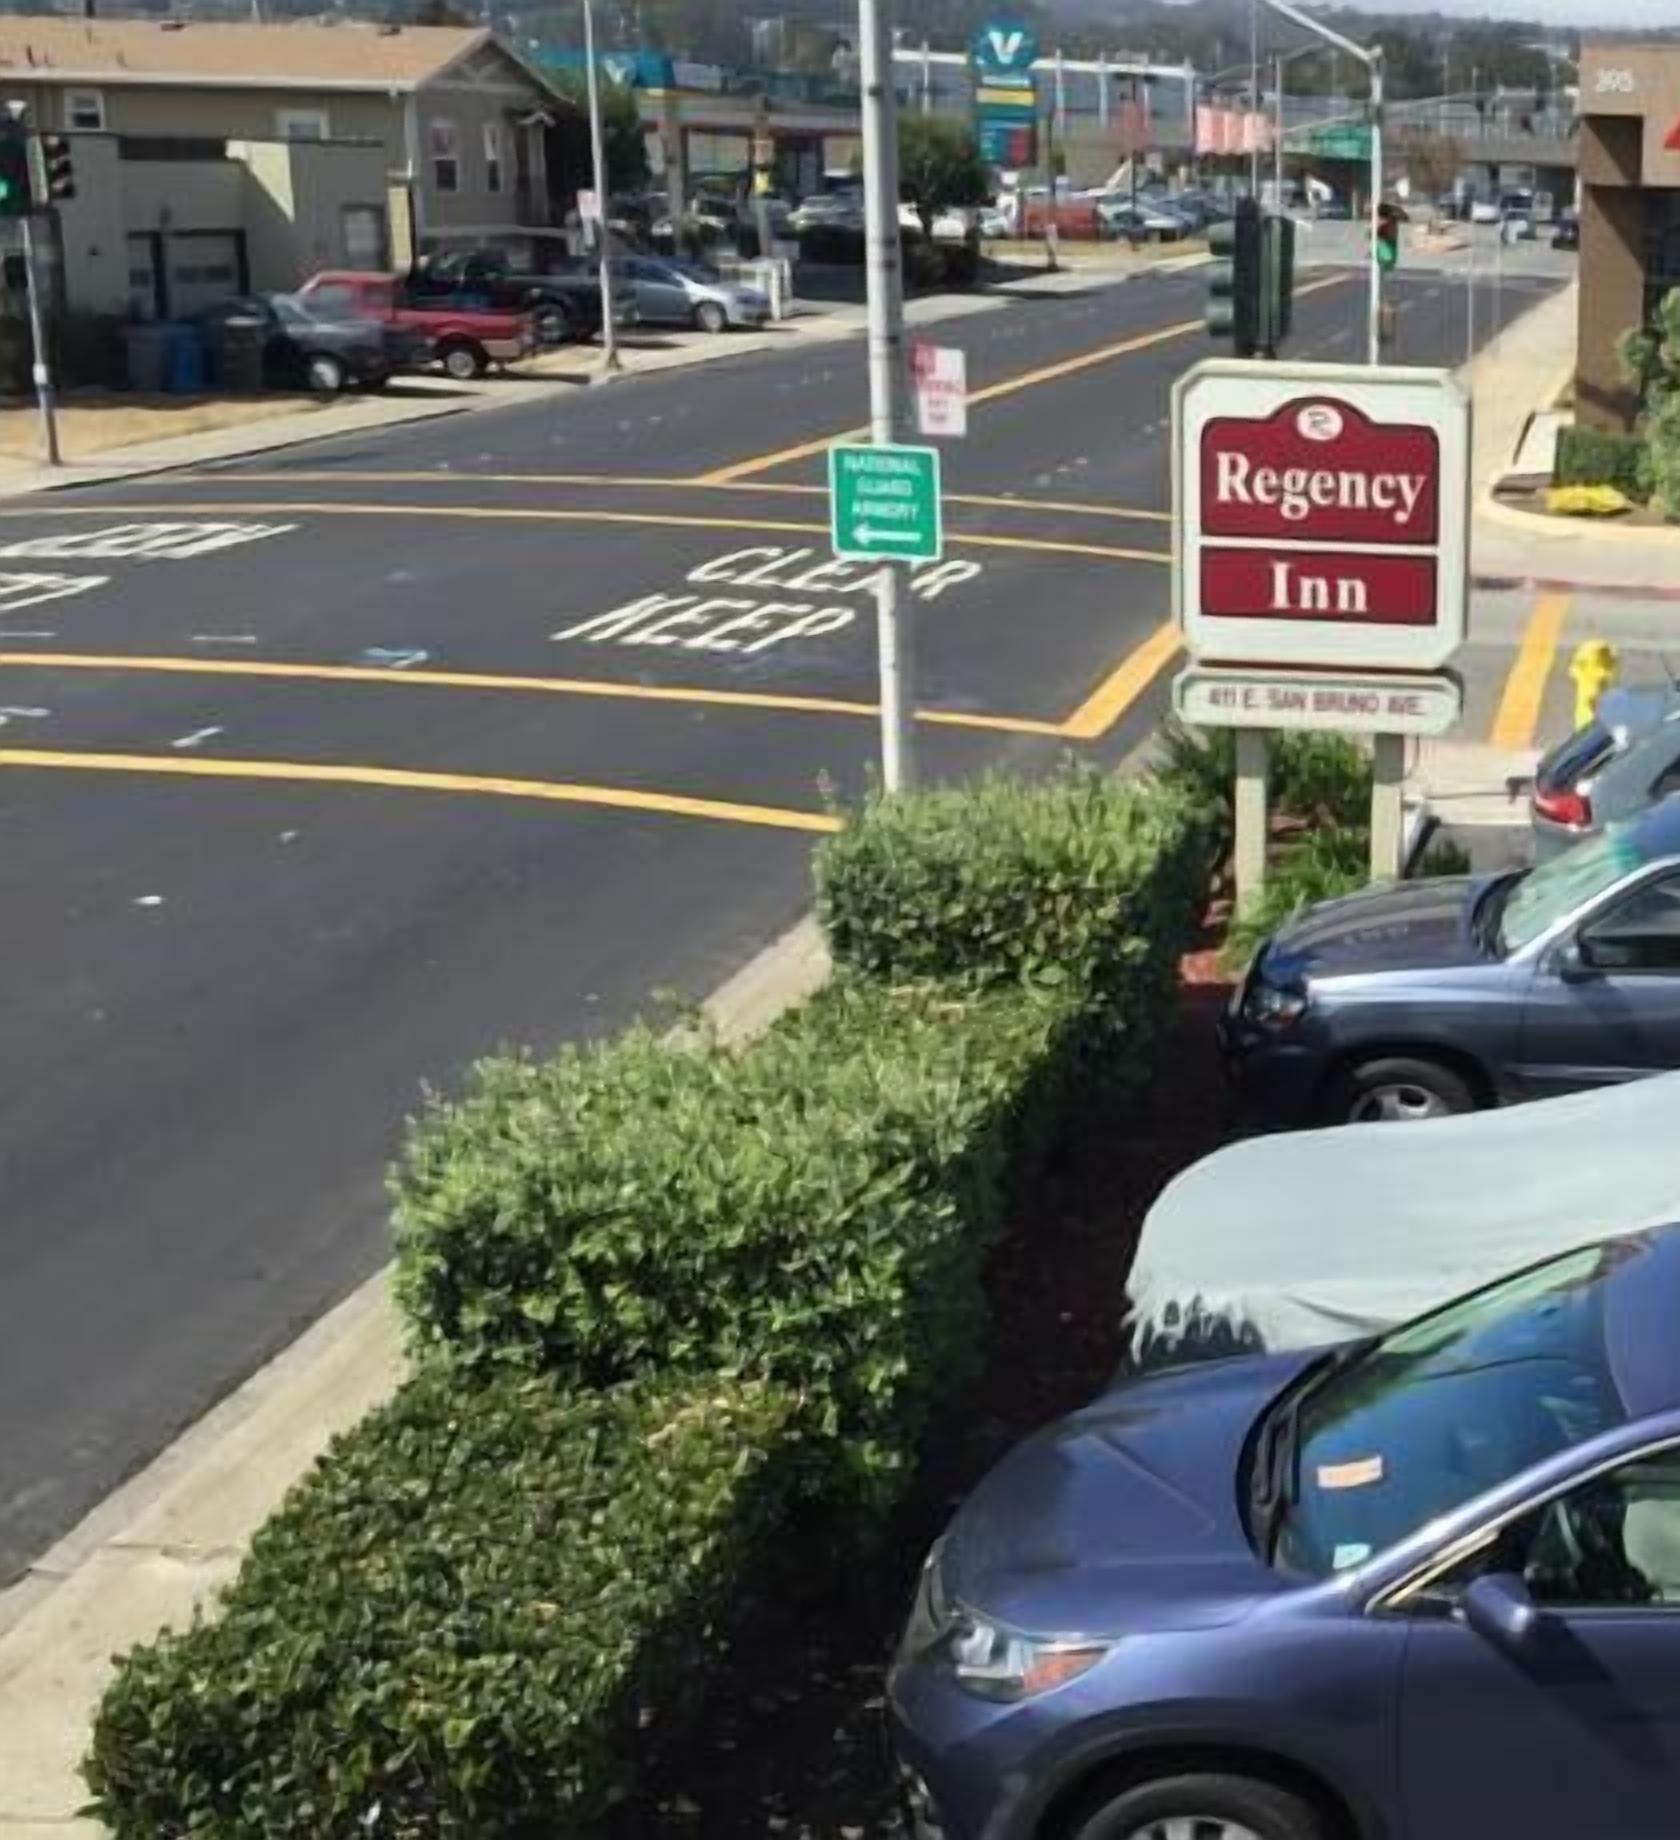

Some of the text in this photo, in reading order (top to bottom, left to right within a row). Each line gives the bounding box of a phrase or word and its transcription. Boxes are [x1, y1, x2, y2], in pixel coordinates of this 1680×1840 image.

[843, 454, 921, 475] NATIONAL
[1215, 451, 1427, 524] Regency
[1271, 562, 1368, 613] Inn
[549, 594, 855, 652] KEEP
